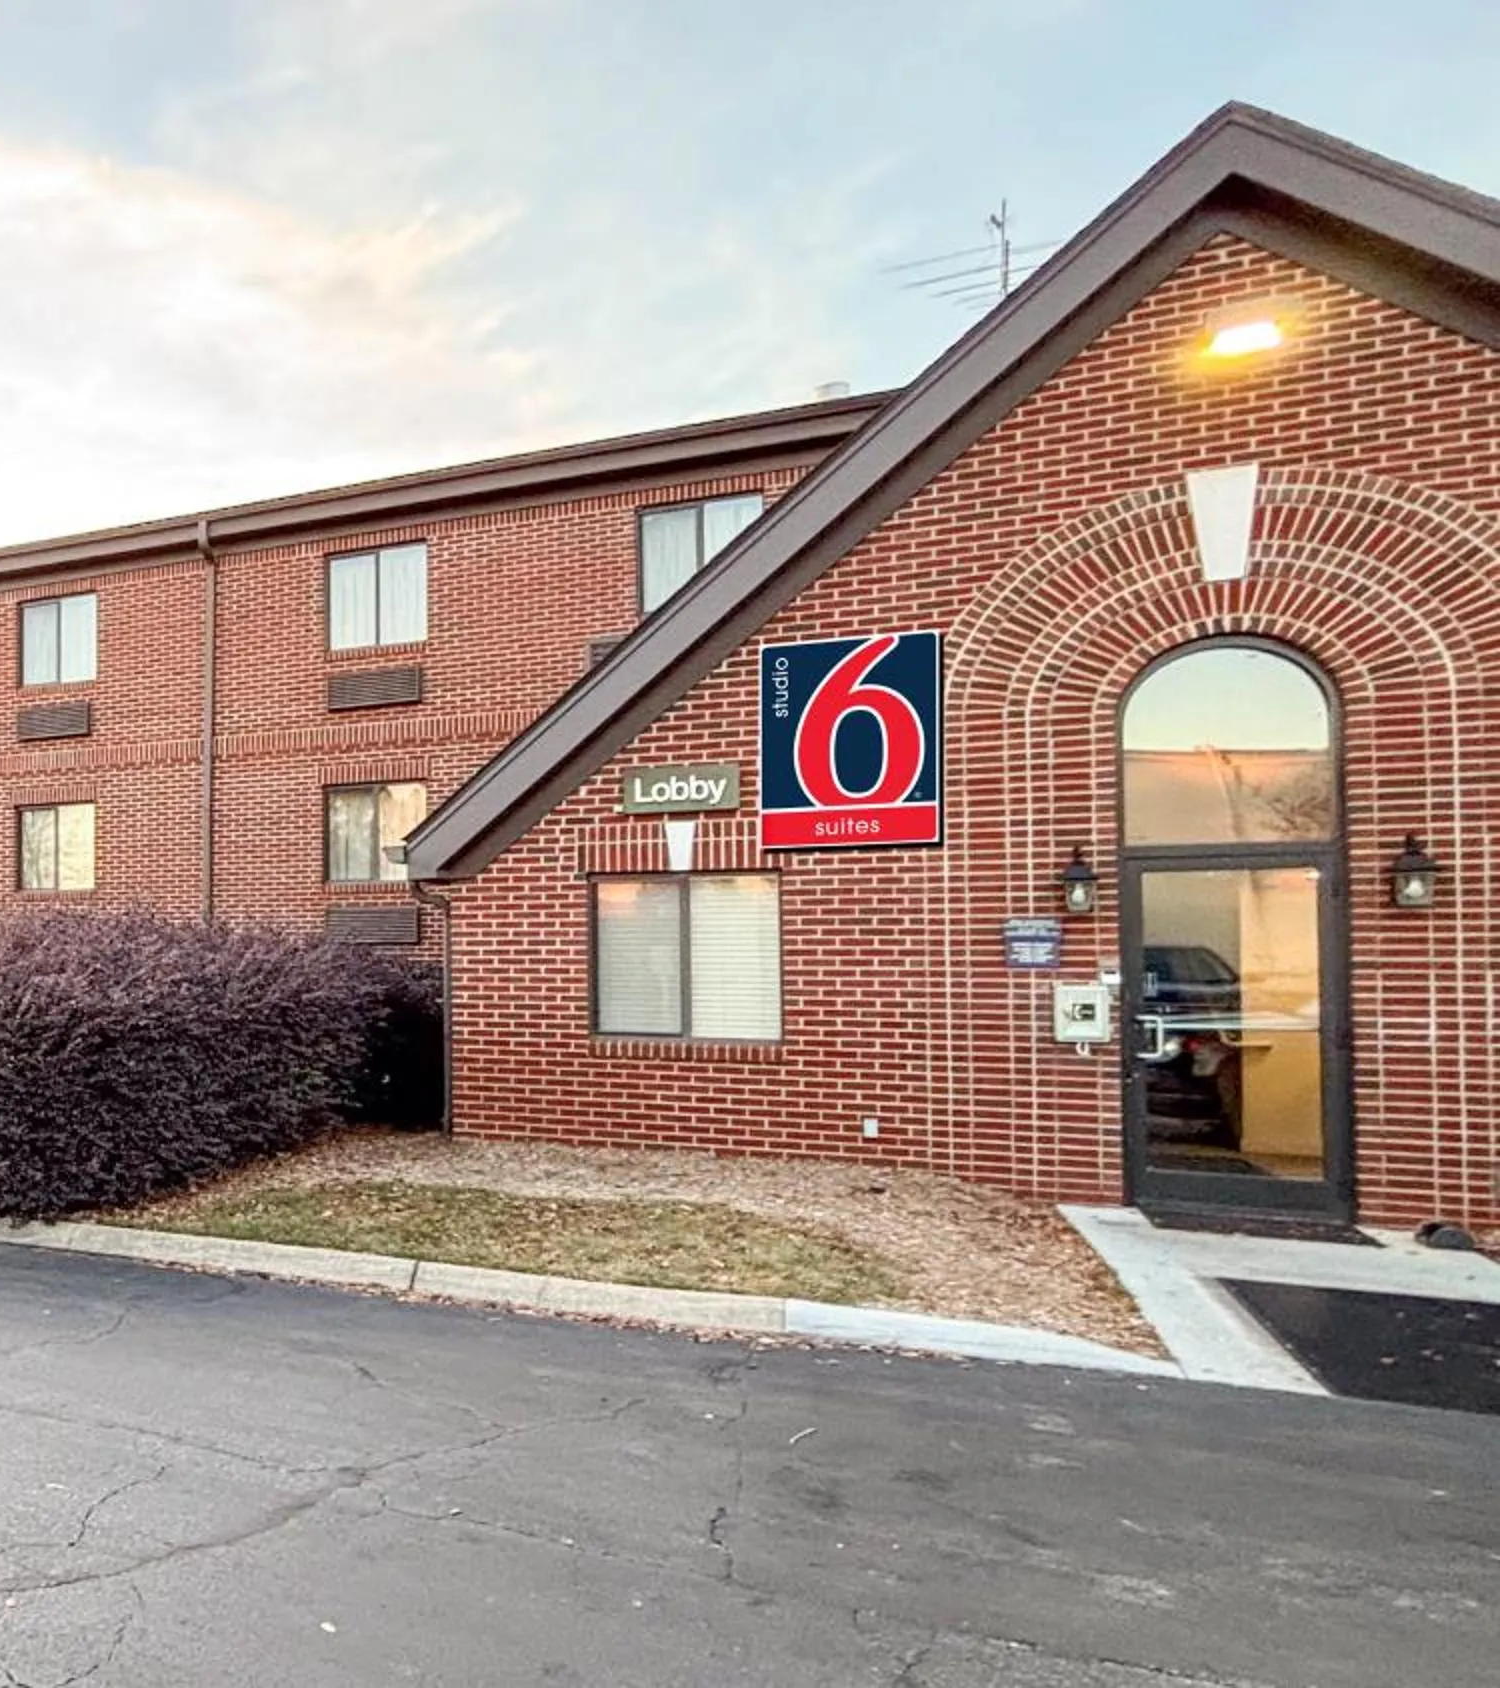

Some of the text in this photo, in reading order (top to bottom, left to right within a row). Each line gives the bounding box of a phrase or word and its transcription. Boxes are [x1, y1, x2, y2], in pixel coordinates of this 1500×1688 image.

[772, 657, 789, 718] studio
[793, 633, 925, 807] 6
[633, 774, 727, 804] Lobby
[814, 817, 881, 837] suites
